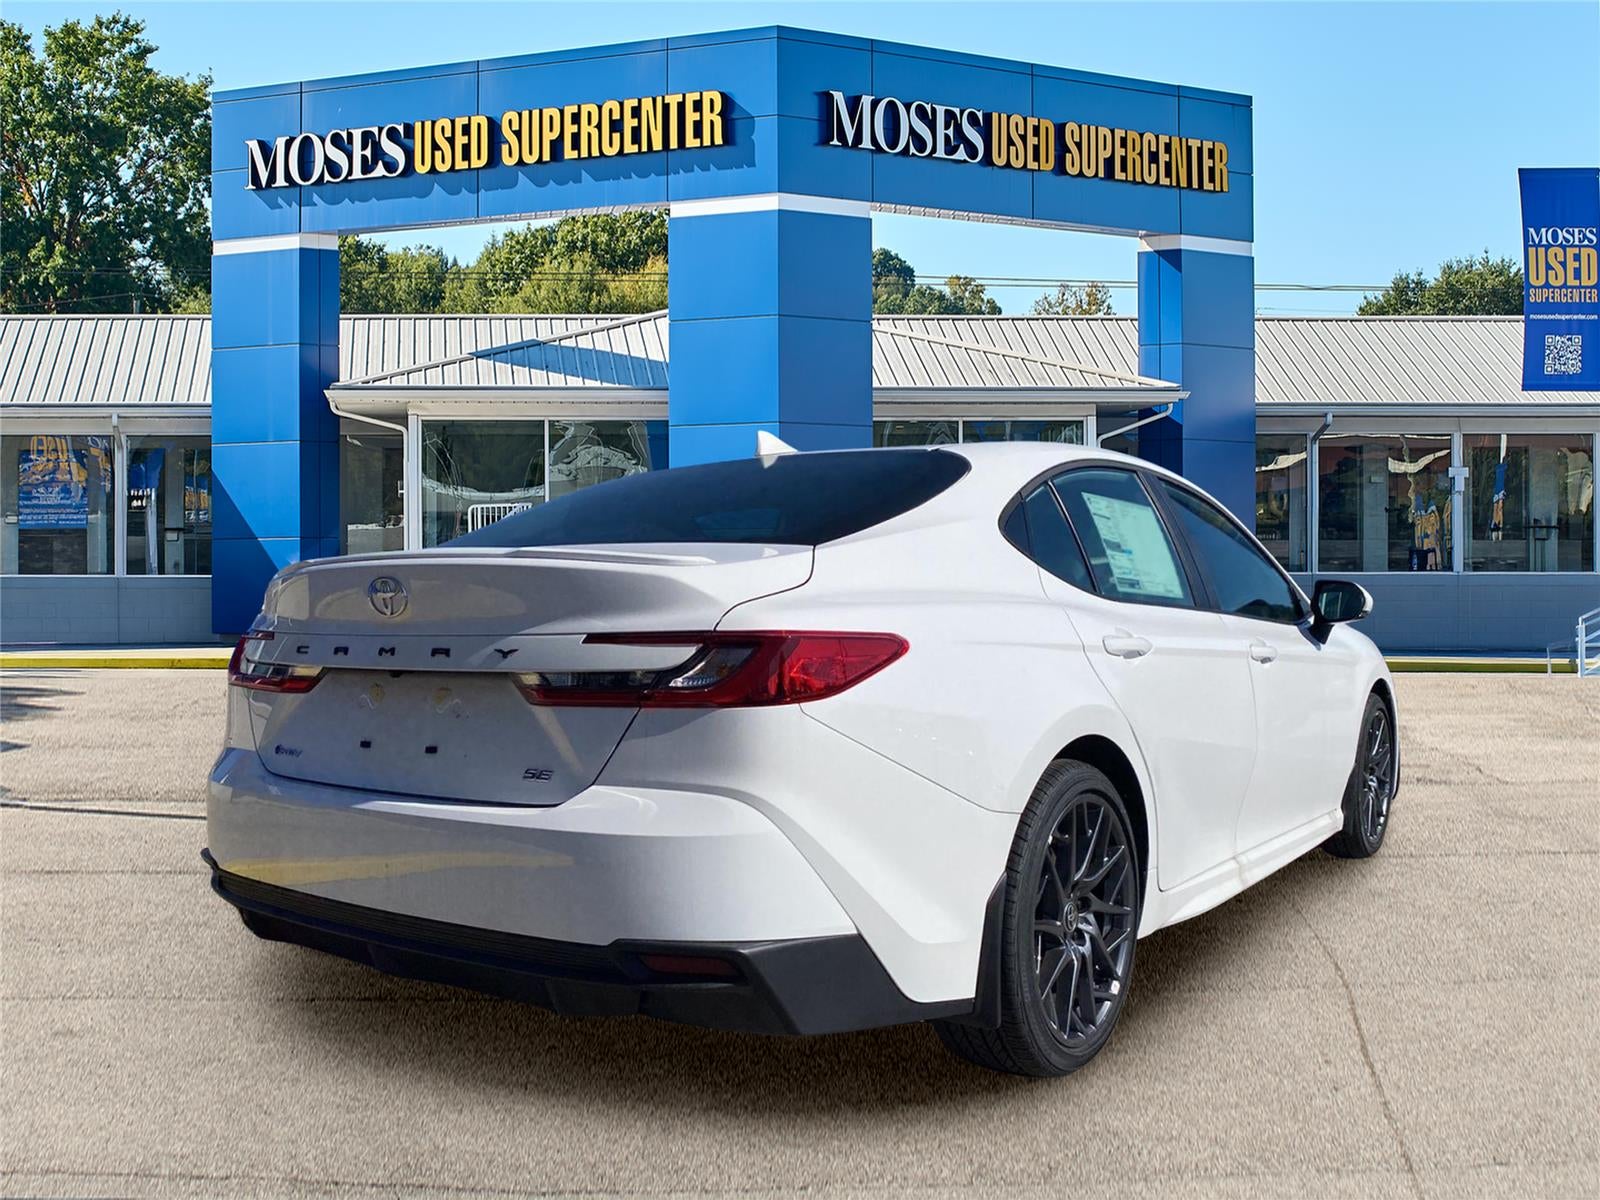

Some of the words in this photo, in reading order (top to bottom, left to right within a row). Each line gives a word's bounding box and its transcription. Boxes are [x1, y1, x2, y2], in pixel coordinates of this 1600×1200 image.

[245, 123, 407, 190] MOSES
[413, 115, 489, 174] USED
[501, 90, 724, 167] SUPERCENTER
[829, 90, 985, 163] MOSES
[991, 111, 1056, 172] USED
[1065, 121, 1230, 193] SUPERCENTER
[1527, 227, 1597, 245] MOSES
[1528, 247, 1598, 286] USED
[1529, 288, 1598, 303] SUPERCENTER
[296, 645, 519, 659] CAMRY
[523, 768, 553, 781] SE
